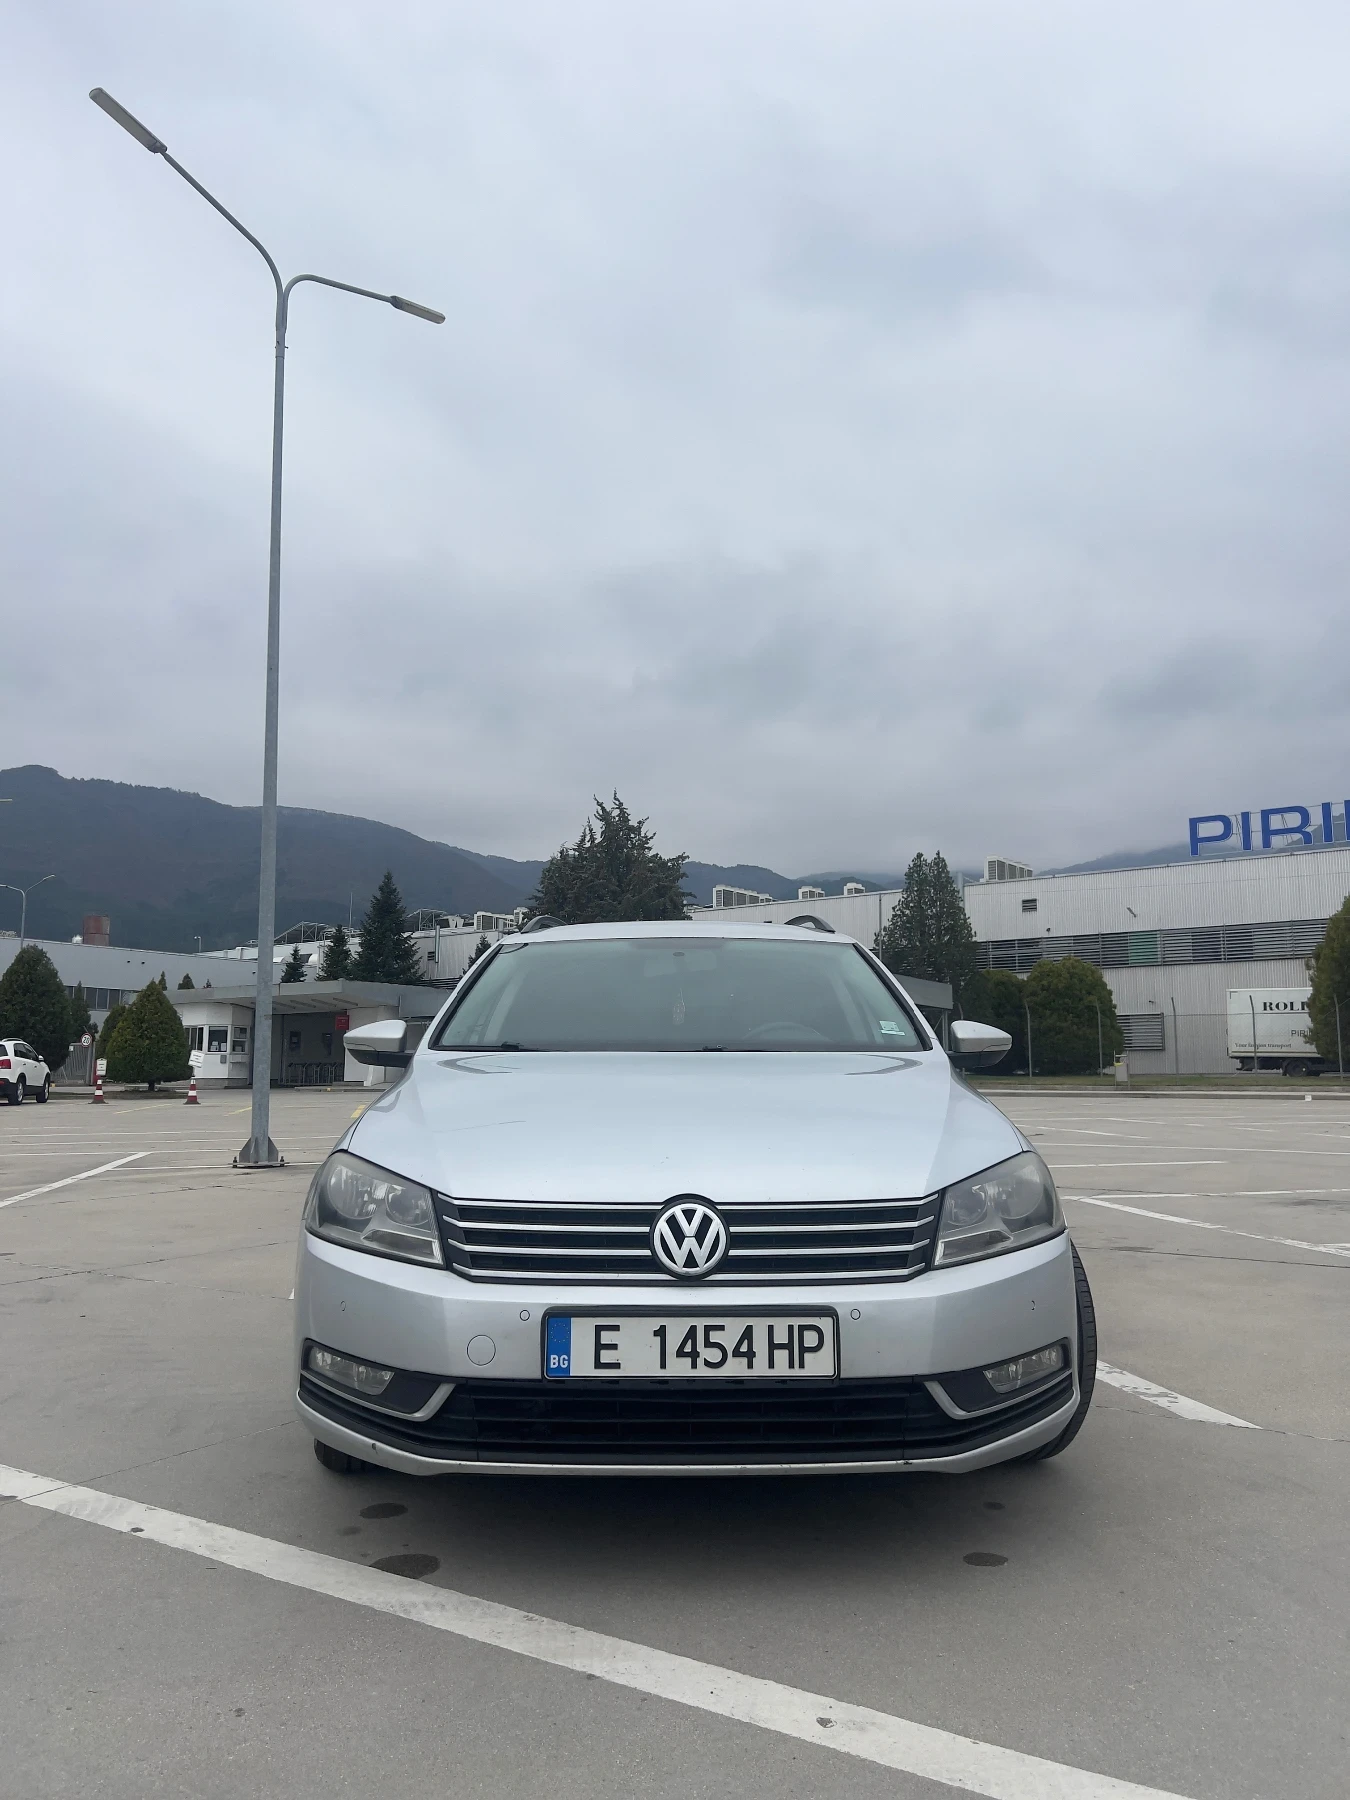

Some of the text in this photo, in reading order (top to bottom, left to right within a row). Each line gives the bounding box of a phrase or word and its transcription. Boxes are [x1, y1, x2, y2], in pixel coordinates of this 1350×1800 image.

[1188, 799, 1350, 857] PIRI
[550, 1354, 569, 1369] BG
[593, 1324, 621, 1370] E
